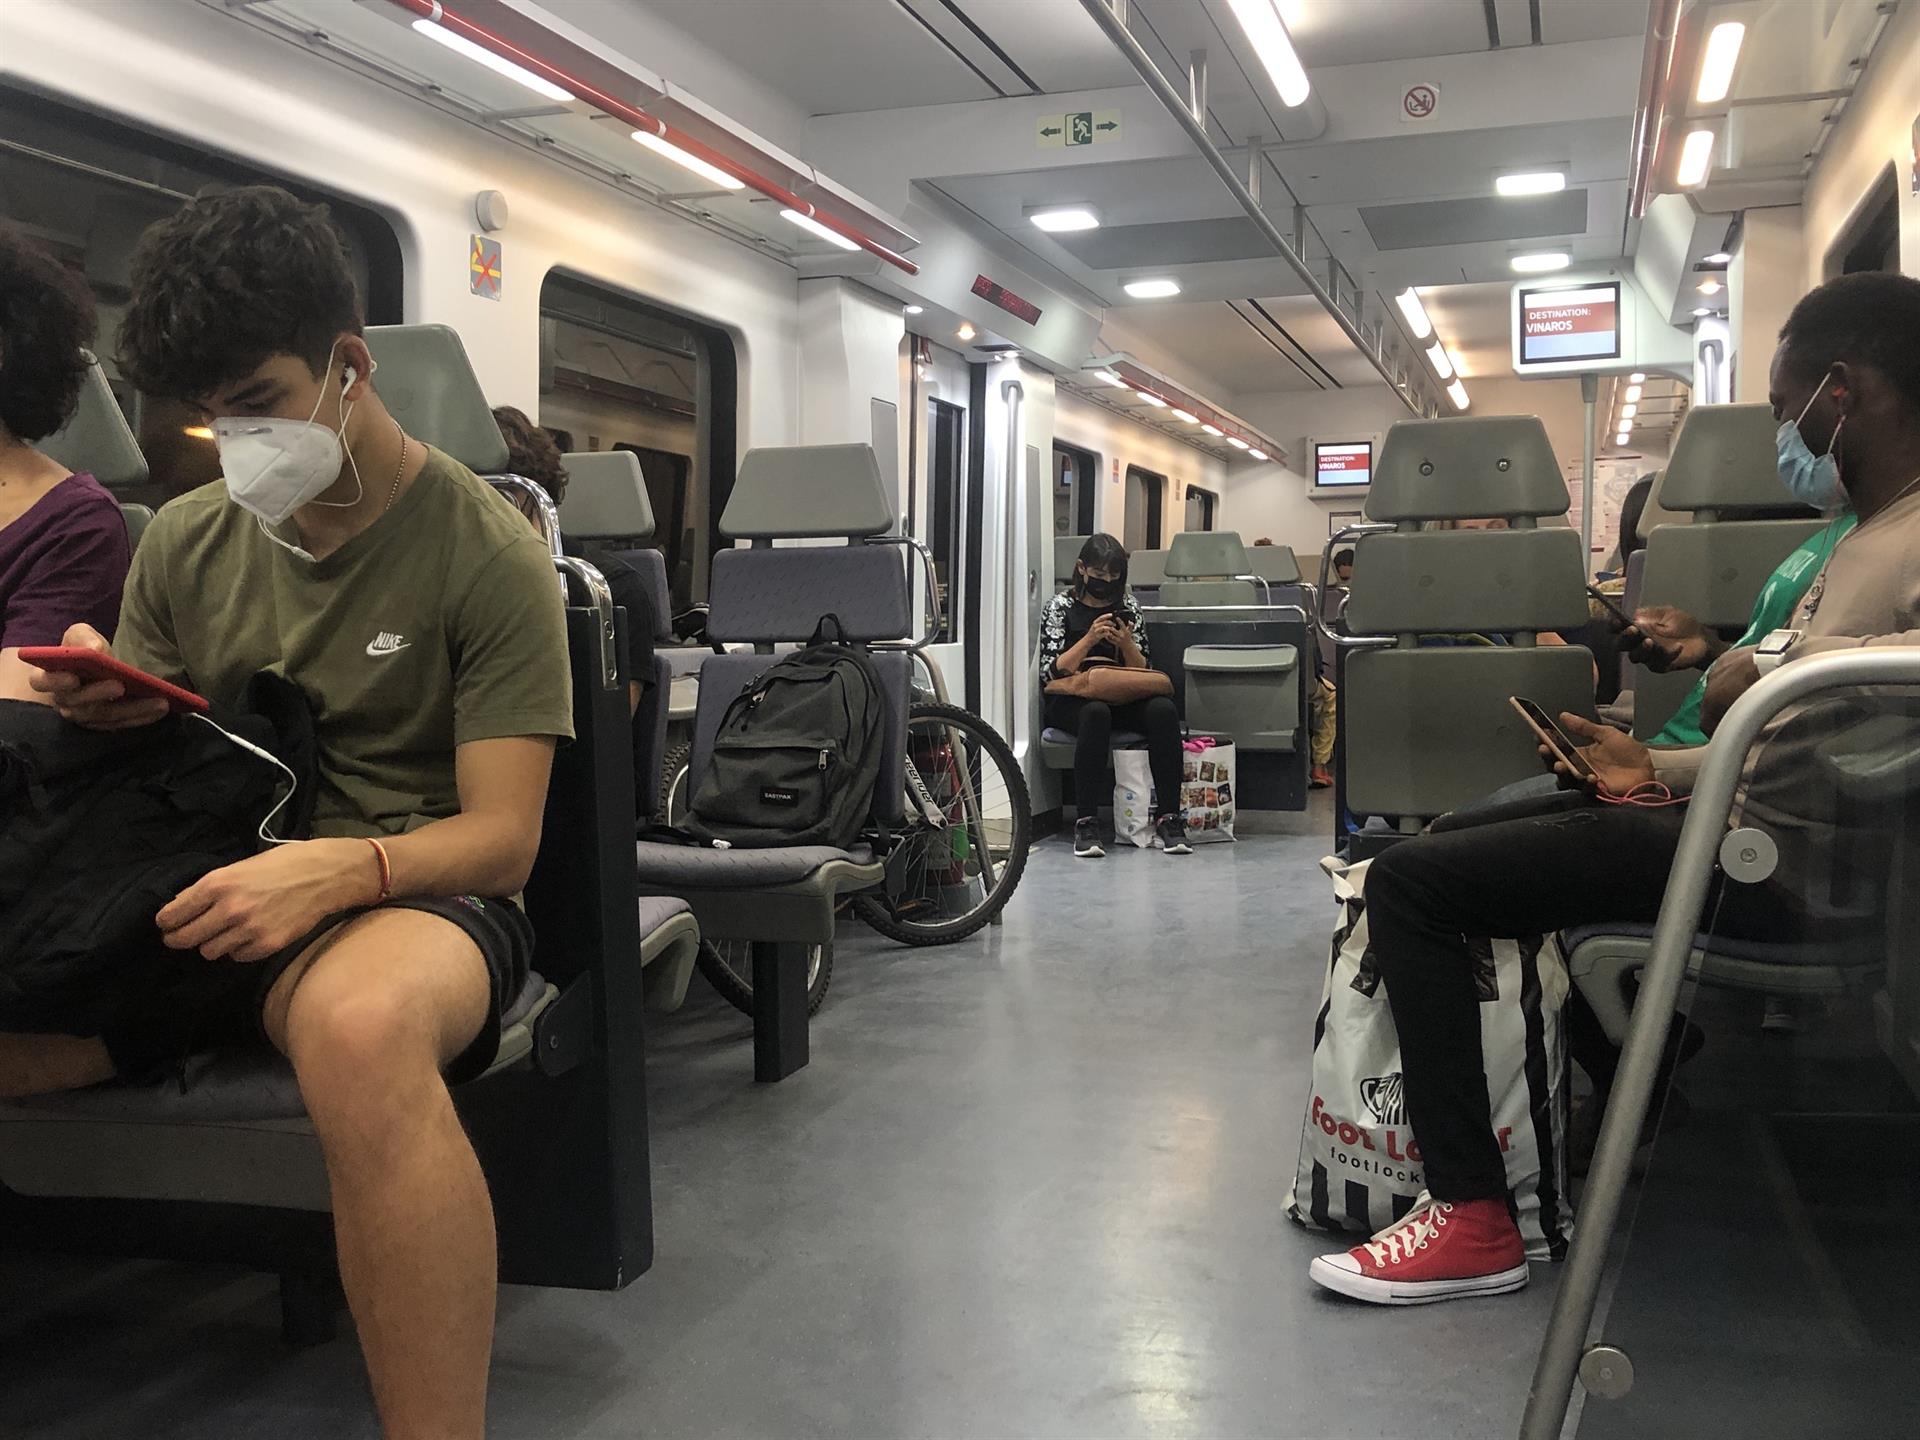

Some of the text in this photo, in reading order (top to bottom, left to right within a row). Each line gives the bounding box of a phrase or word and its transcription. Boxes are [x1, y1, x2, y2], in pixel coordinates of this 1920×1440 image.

[1529, 307, 1592, 321] DESTINATION:
[1526, 320, 1573, 334] VINAROS
[1319, 462, 1346, 470] VINAROS
[373, 631, 404, 649] NIKE
[764, 792, 792, 800] EASTPAK
[1311, 1095, 1513, 1163] Foot Lor
[1330, 1146, 1422, 1184] footlock
